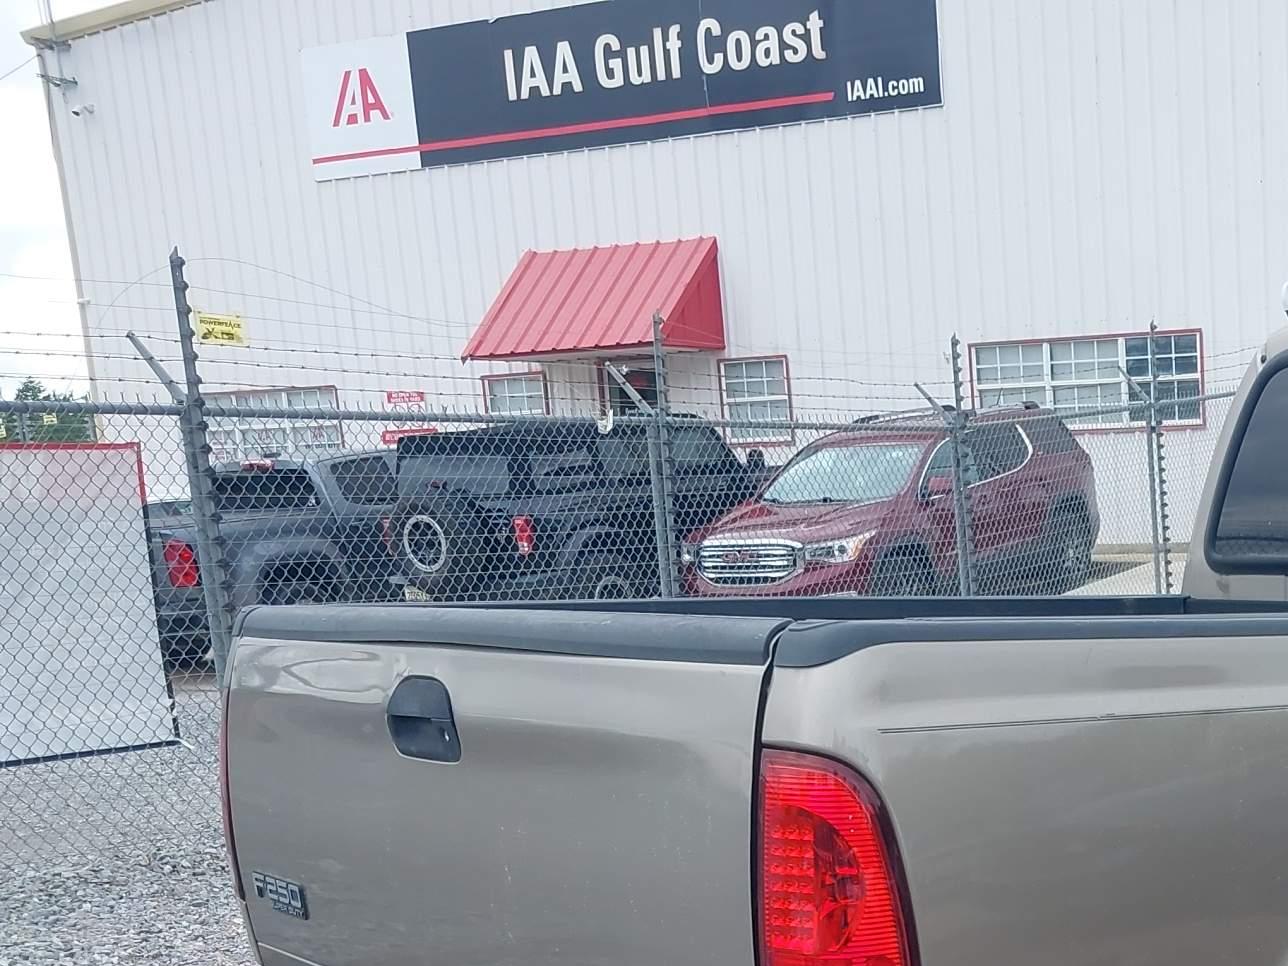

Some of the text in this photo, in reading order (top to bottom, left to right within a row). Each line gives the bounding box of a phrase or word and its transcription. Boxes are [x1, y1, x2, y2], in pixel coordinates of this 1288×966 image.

[503, 9, 827, 101] IAA Gulf Coast
[846, 76, 924, 102] IAAI.com
